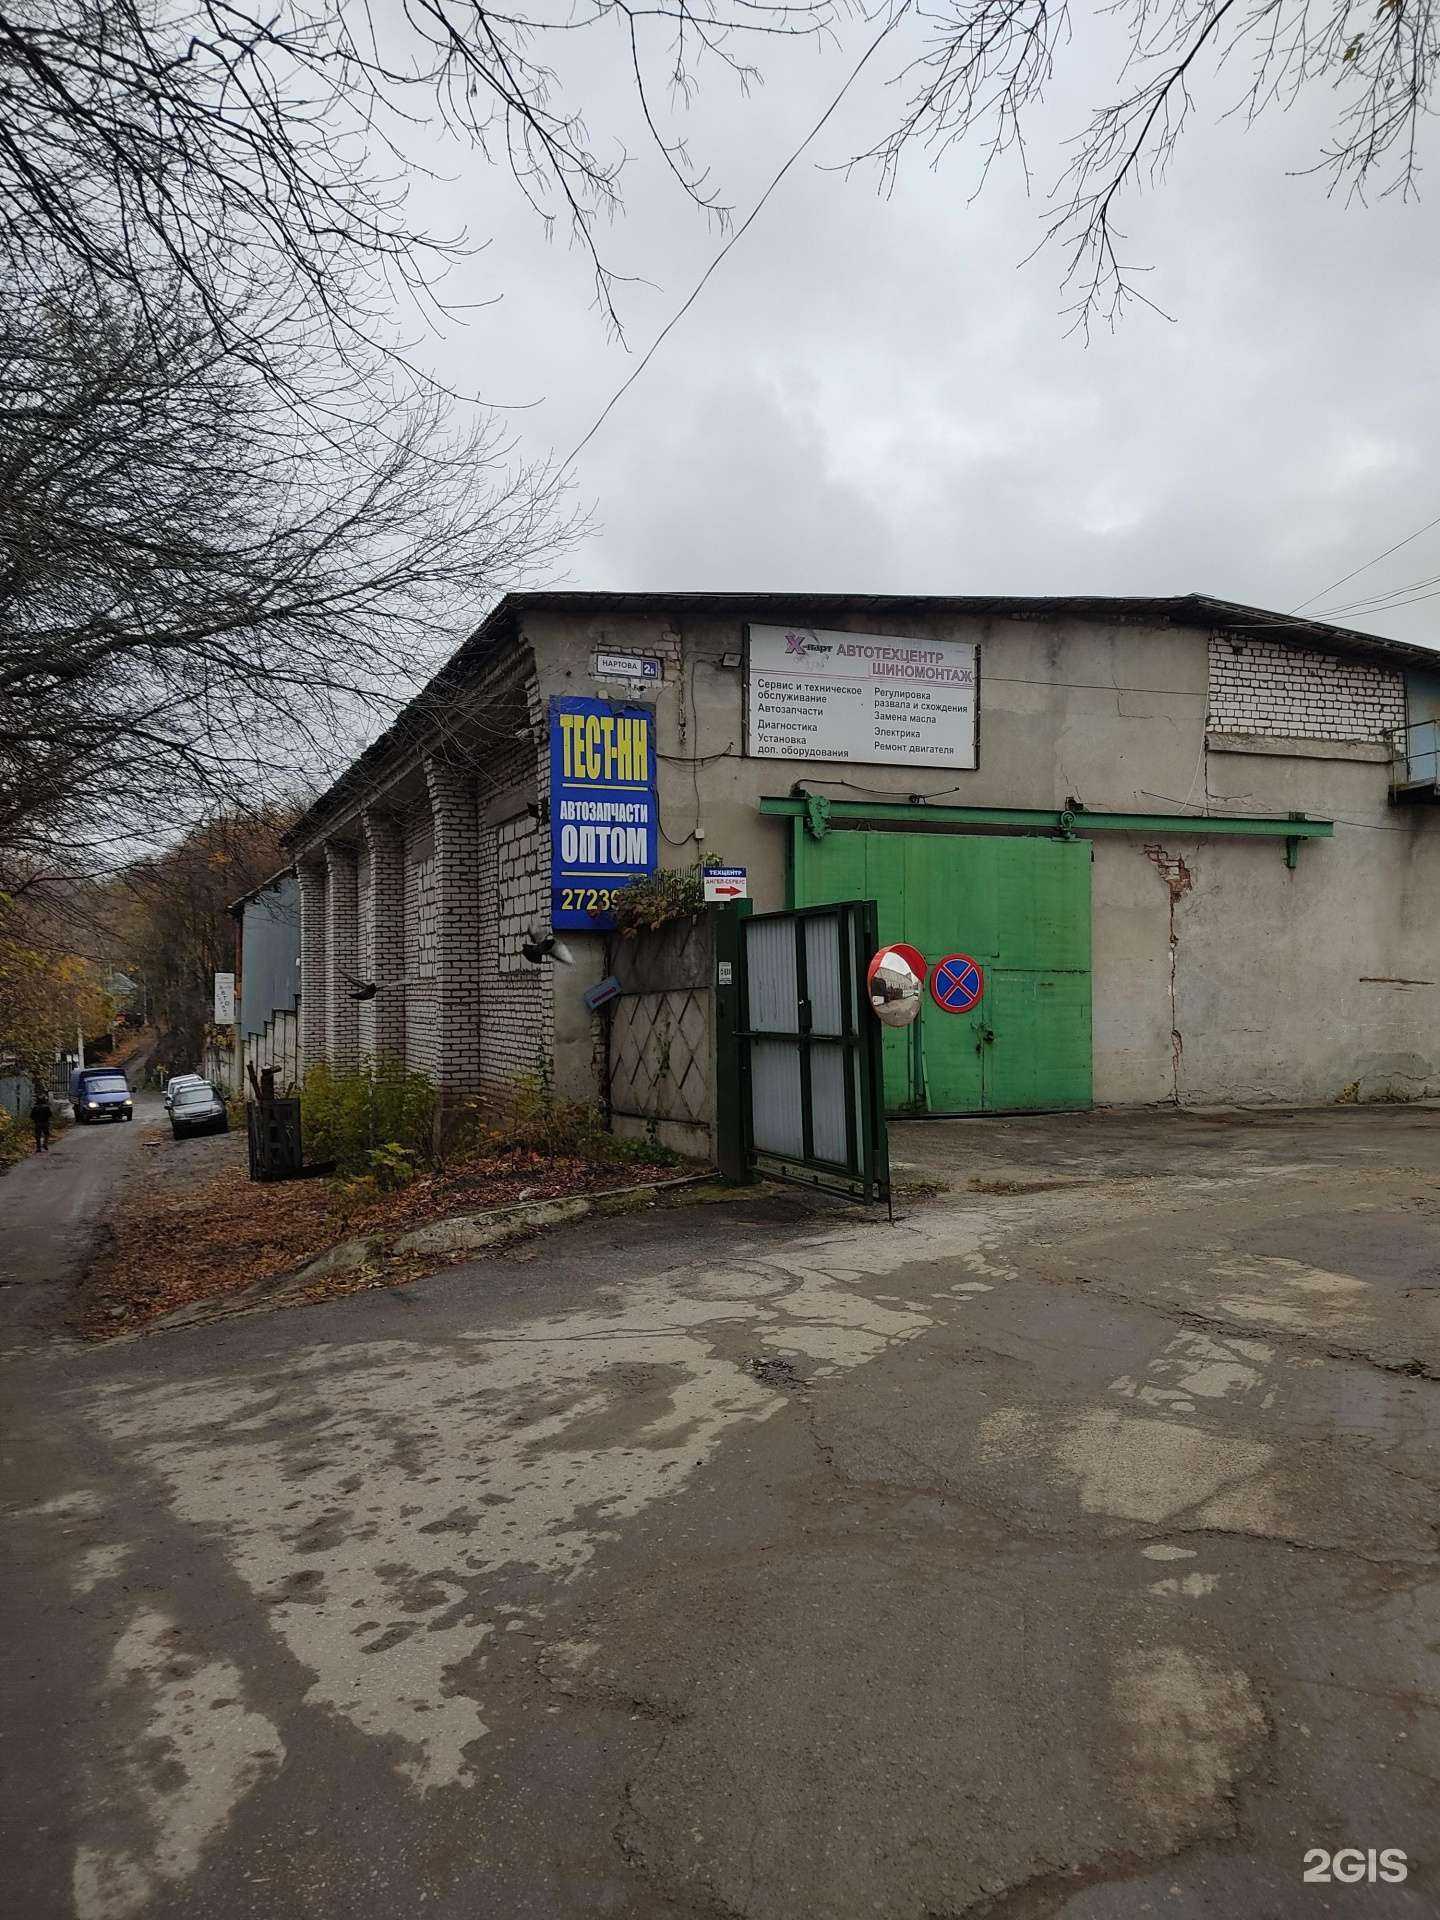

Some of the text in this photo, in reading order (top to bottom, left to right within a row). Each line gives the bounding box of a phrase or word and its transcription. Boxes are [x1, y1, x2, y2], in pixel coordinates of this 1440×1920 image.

[836, 643, 944, 664] АВТОТЕХЦЕНТР
[602, 659, 638, 670] НАРТОВА
[872, 662, 973, 683] ШИНОМОНТАЖ
[757, 678, 794, 691] Сервис
[805, 683, 863, 695] техническое
[757, 690, 828, 703] обслуживание
[874, 687, 931, 700] Регулировка
[757, 703, 824, 716] Автозапчасти
[874, 700, 911, 709] развала
[921, 703, 968, 713] схождения
[874, 711, 937, 724] Замена масла
[757, 719, 818, 732] Диагностика
[874, 726, 921, 738] Электрика
[757, 733, 807, 745] Установка
[560, 714, 648, 781] ТЕСТ-НН
[757, 746, 849, 758] доп. оборудования
[874, 741, 954, 755] Ремонт двигателя
[560, 800, 648, 823] АВТОЗАПЧАСТИ
[561, 824, 648, 865] ОПТОМ
[709, 869, 743, 877] ТЕХЦЕНТР
